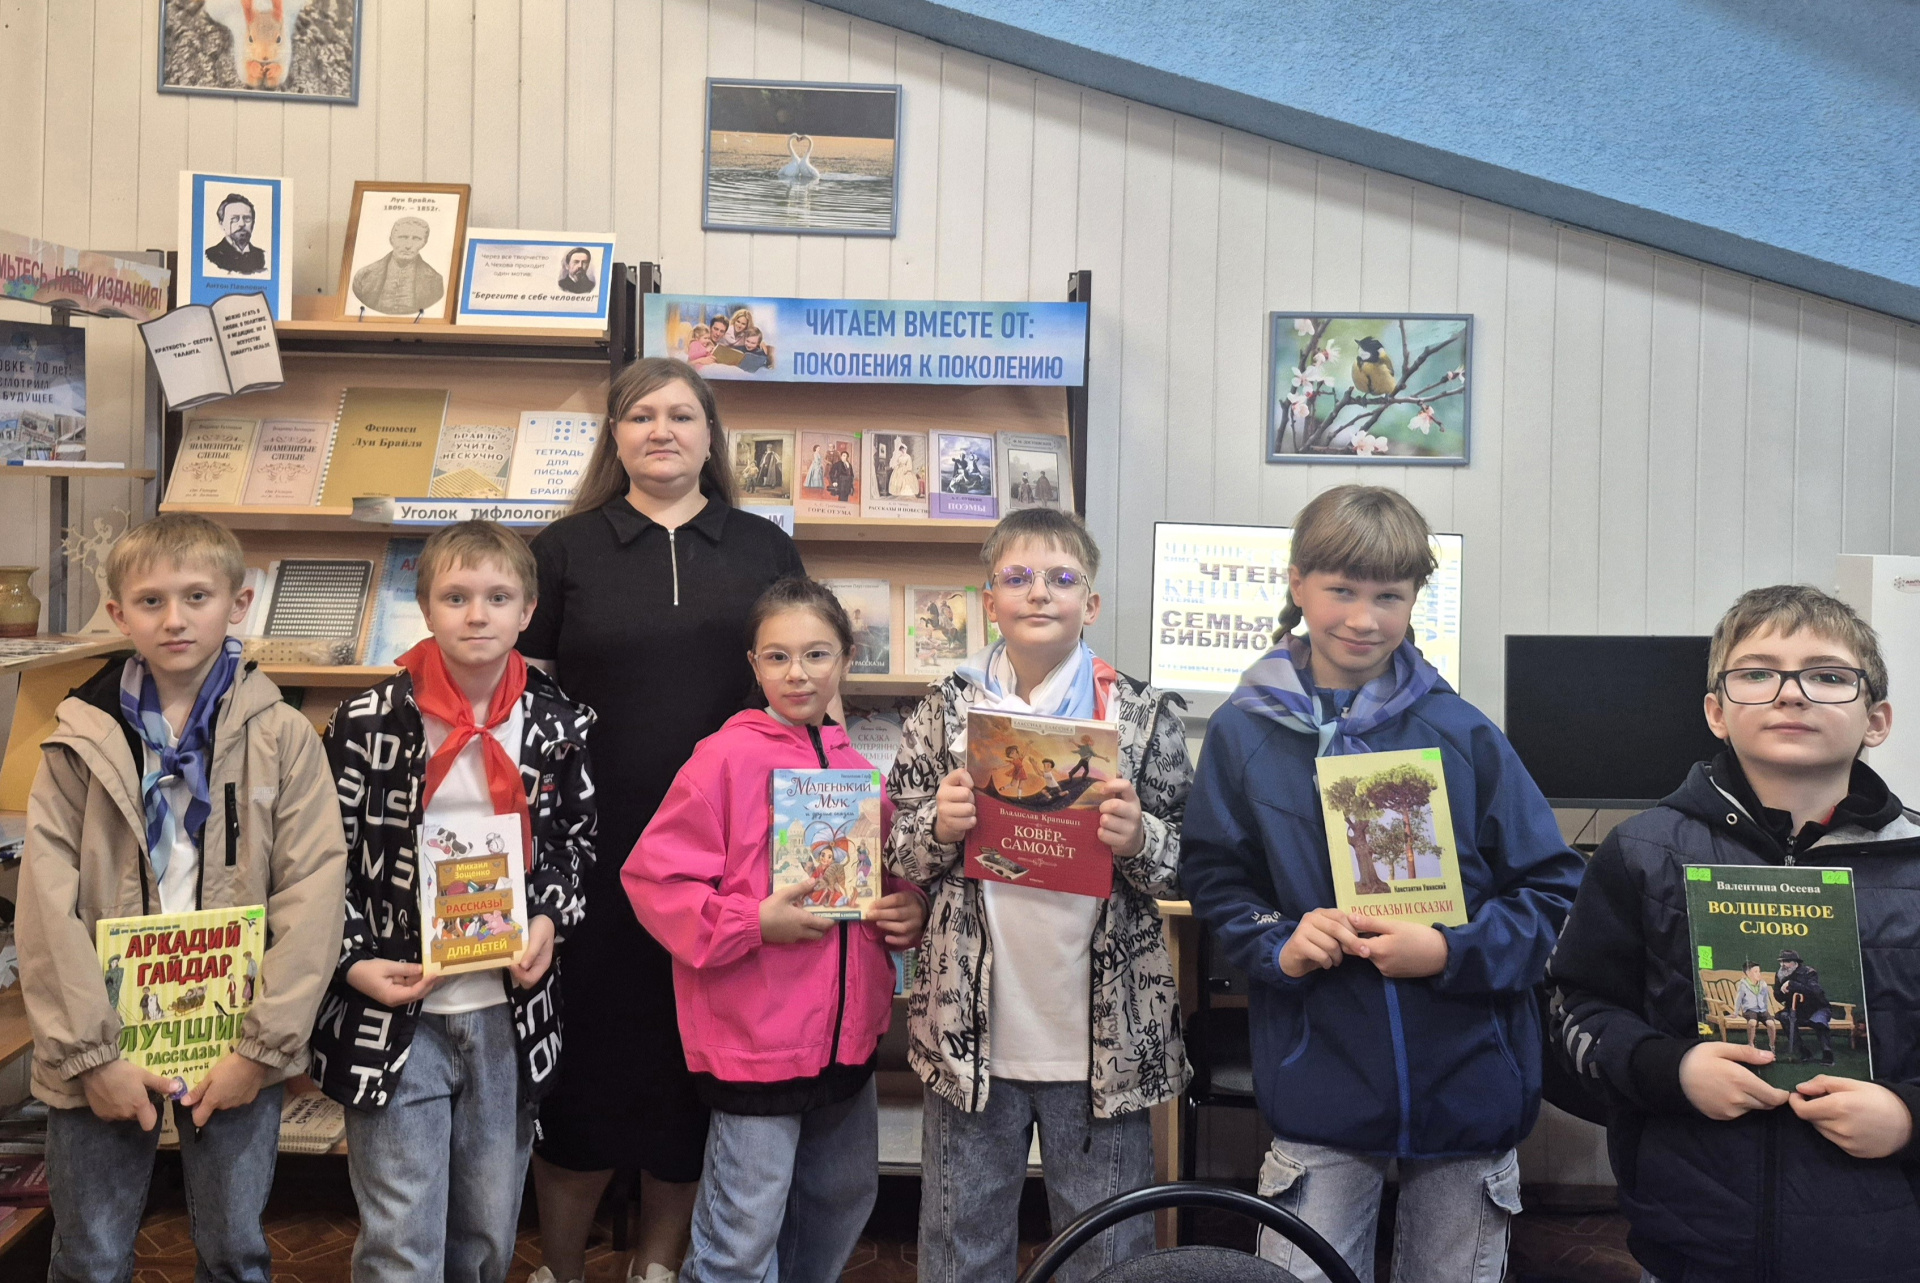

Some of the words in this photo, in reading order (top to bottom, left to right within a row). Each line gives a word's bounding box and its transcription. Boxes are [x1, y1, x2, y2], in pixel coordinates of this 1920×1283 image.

[55, 266, 94, 297] НАШИ
[97, 275, 162, 310] ИЗДАНИЯ!
[806, 309, 896, 337] ЧИТАЕМ
[904, 310, 992, 339] ВМЕСТЕ
[1001, 311, 1034, 339] ОТ:
[155, 341, 186, 354] КРАТКОСТЬ
[193, 337, 214, 346] СЕСТРА
[36, 361, 49, 374] 70
[52, 364, 72, 376] лет!
[793, 351, 912, 378] ПОКОЛЕНИЯ
[920, 353, 933, 378] К
[938, 353, 1064, 380] ПОКОЛЕНИЮ
[2, 391, 54, 403] БУДУЩЕЕ
[365, 423, 417, 434] Феномен
[189, 442, 243, 451] ЗНАМЕНИТЫЕ
[263, 444, 317, 453] ЗНАМЕНИТЫЕ
[352, 438, 376, 449] Луи
[379, 438, 423, 449] Брайля
[456, 442, 494, 451] УЧИТЬ
[197, 452, 230, 460] СЛЕПЫЕ
[271, 453, 305, 461] СЛЕПЫЕ
[442, 452, 504, 462] НЕСКУЧНО
[535, 449, 584, 457] ТЕТРАДЬ
[546, 459, 569, 467] ДЛЯ
[534, 469, 579, 477] ПИСЬМА
[401, 507, 458, 522] Уголок
[948, 502, 986, 512] ПОЭМЫ
[1161, 610, 1274, 633] СЕМЬЯ
[1160, 627, 1268, 651] БИБЛИО
[858, 734, 890, 742] СКАЗКА
[1000, 807, 1039, 821] Владислав
[1041, 814, 1081, 827] Крапивин
[1013, 825, 1067, 843] КОВЁР-
[1001, 838, 1076, 859] САМОЛЁТ
[456, 862, 488, 871] Михаил
[454, 869, 491, 880] Зощенко
[1394, 885, 1422, 893] Константин
[1422, 882, 1446, 891] Ушинский
[1716, 880, 1777, 893] Валентина
[1780, 882, 1821, 894] Осеева
[446, 899, 503, 914] РАССКАЗЫ
[1351, 902, 1403, 917] РАССКАЗЫ
[1405, 903, 1412, 914] И
[1414, 900, 1453, 914] СКАЗКИ
[1708, 900, 1834, 919] ВОЛШЕБНОЕ
[1740, 920, 1809, 937] СЛОВО
[125, 921, 242, 959] АРКАДИЙ
[447, 945, 471, 959] ДЛЯ
[473, 938, 508, 956] ДЕТЕЙ
[137, 954, 232, 987] ГАЙДАР
[146, 1044, 221, 1066] РАССКАЗЫ
